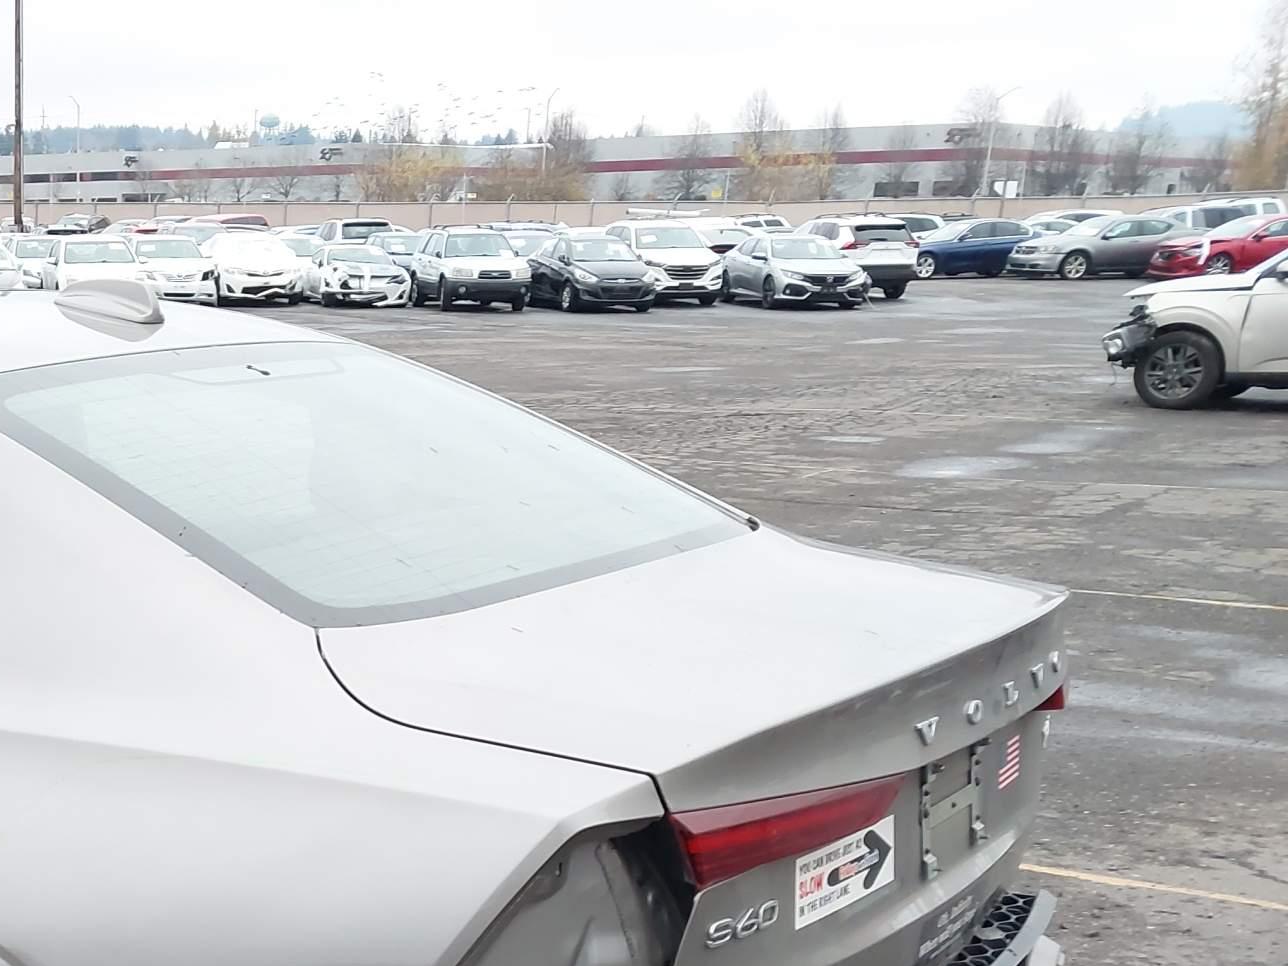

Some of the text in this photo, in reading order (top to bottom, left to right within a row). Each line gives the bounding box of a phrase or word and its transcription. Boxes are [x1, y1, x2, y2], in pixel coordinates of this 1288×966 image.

[914, 651, 1060, 746] VOLVO
[799, 871, 824, 899] SLOW
[706, 899, 779, 948] S60
